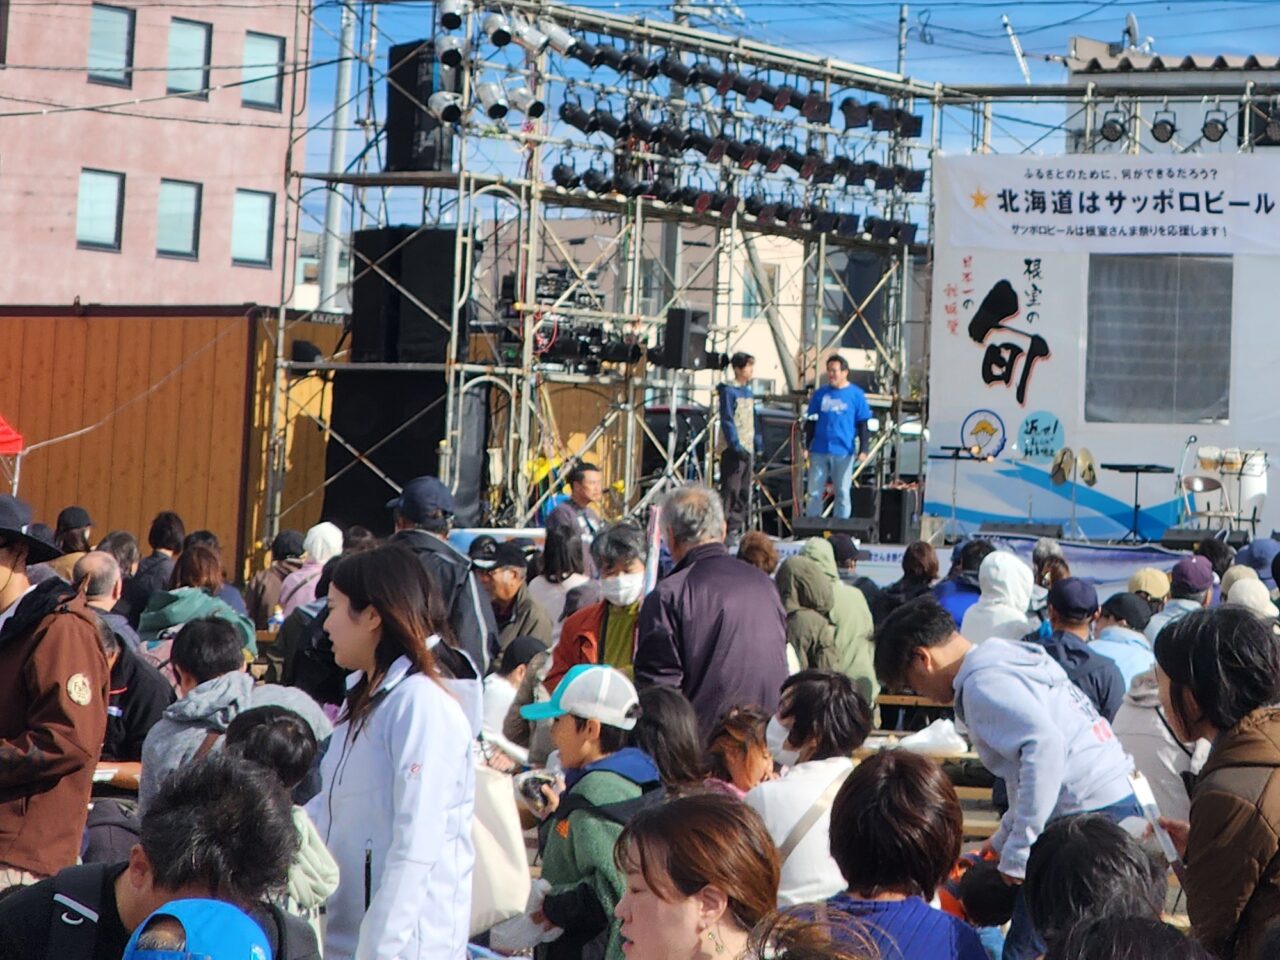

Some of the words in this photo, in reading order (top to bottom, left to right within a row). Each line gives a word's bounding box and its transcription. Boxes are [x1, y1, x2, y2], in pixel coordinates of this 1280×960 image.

[997, 187, 1276, 215] 北海道はサッポロビール
[968, 278, 1050, 407] 旬
